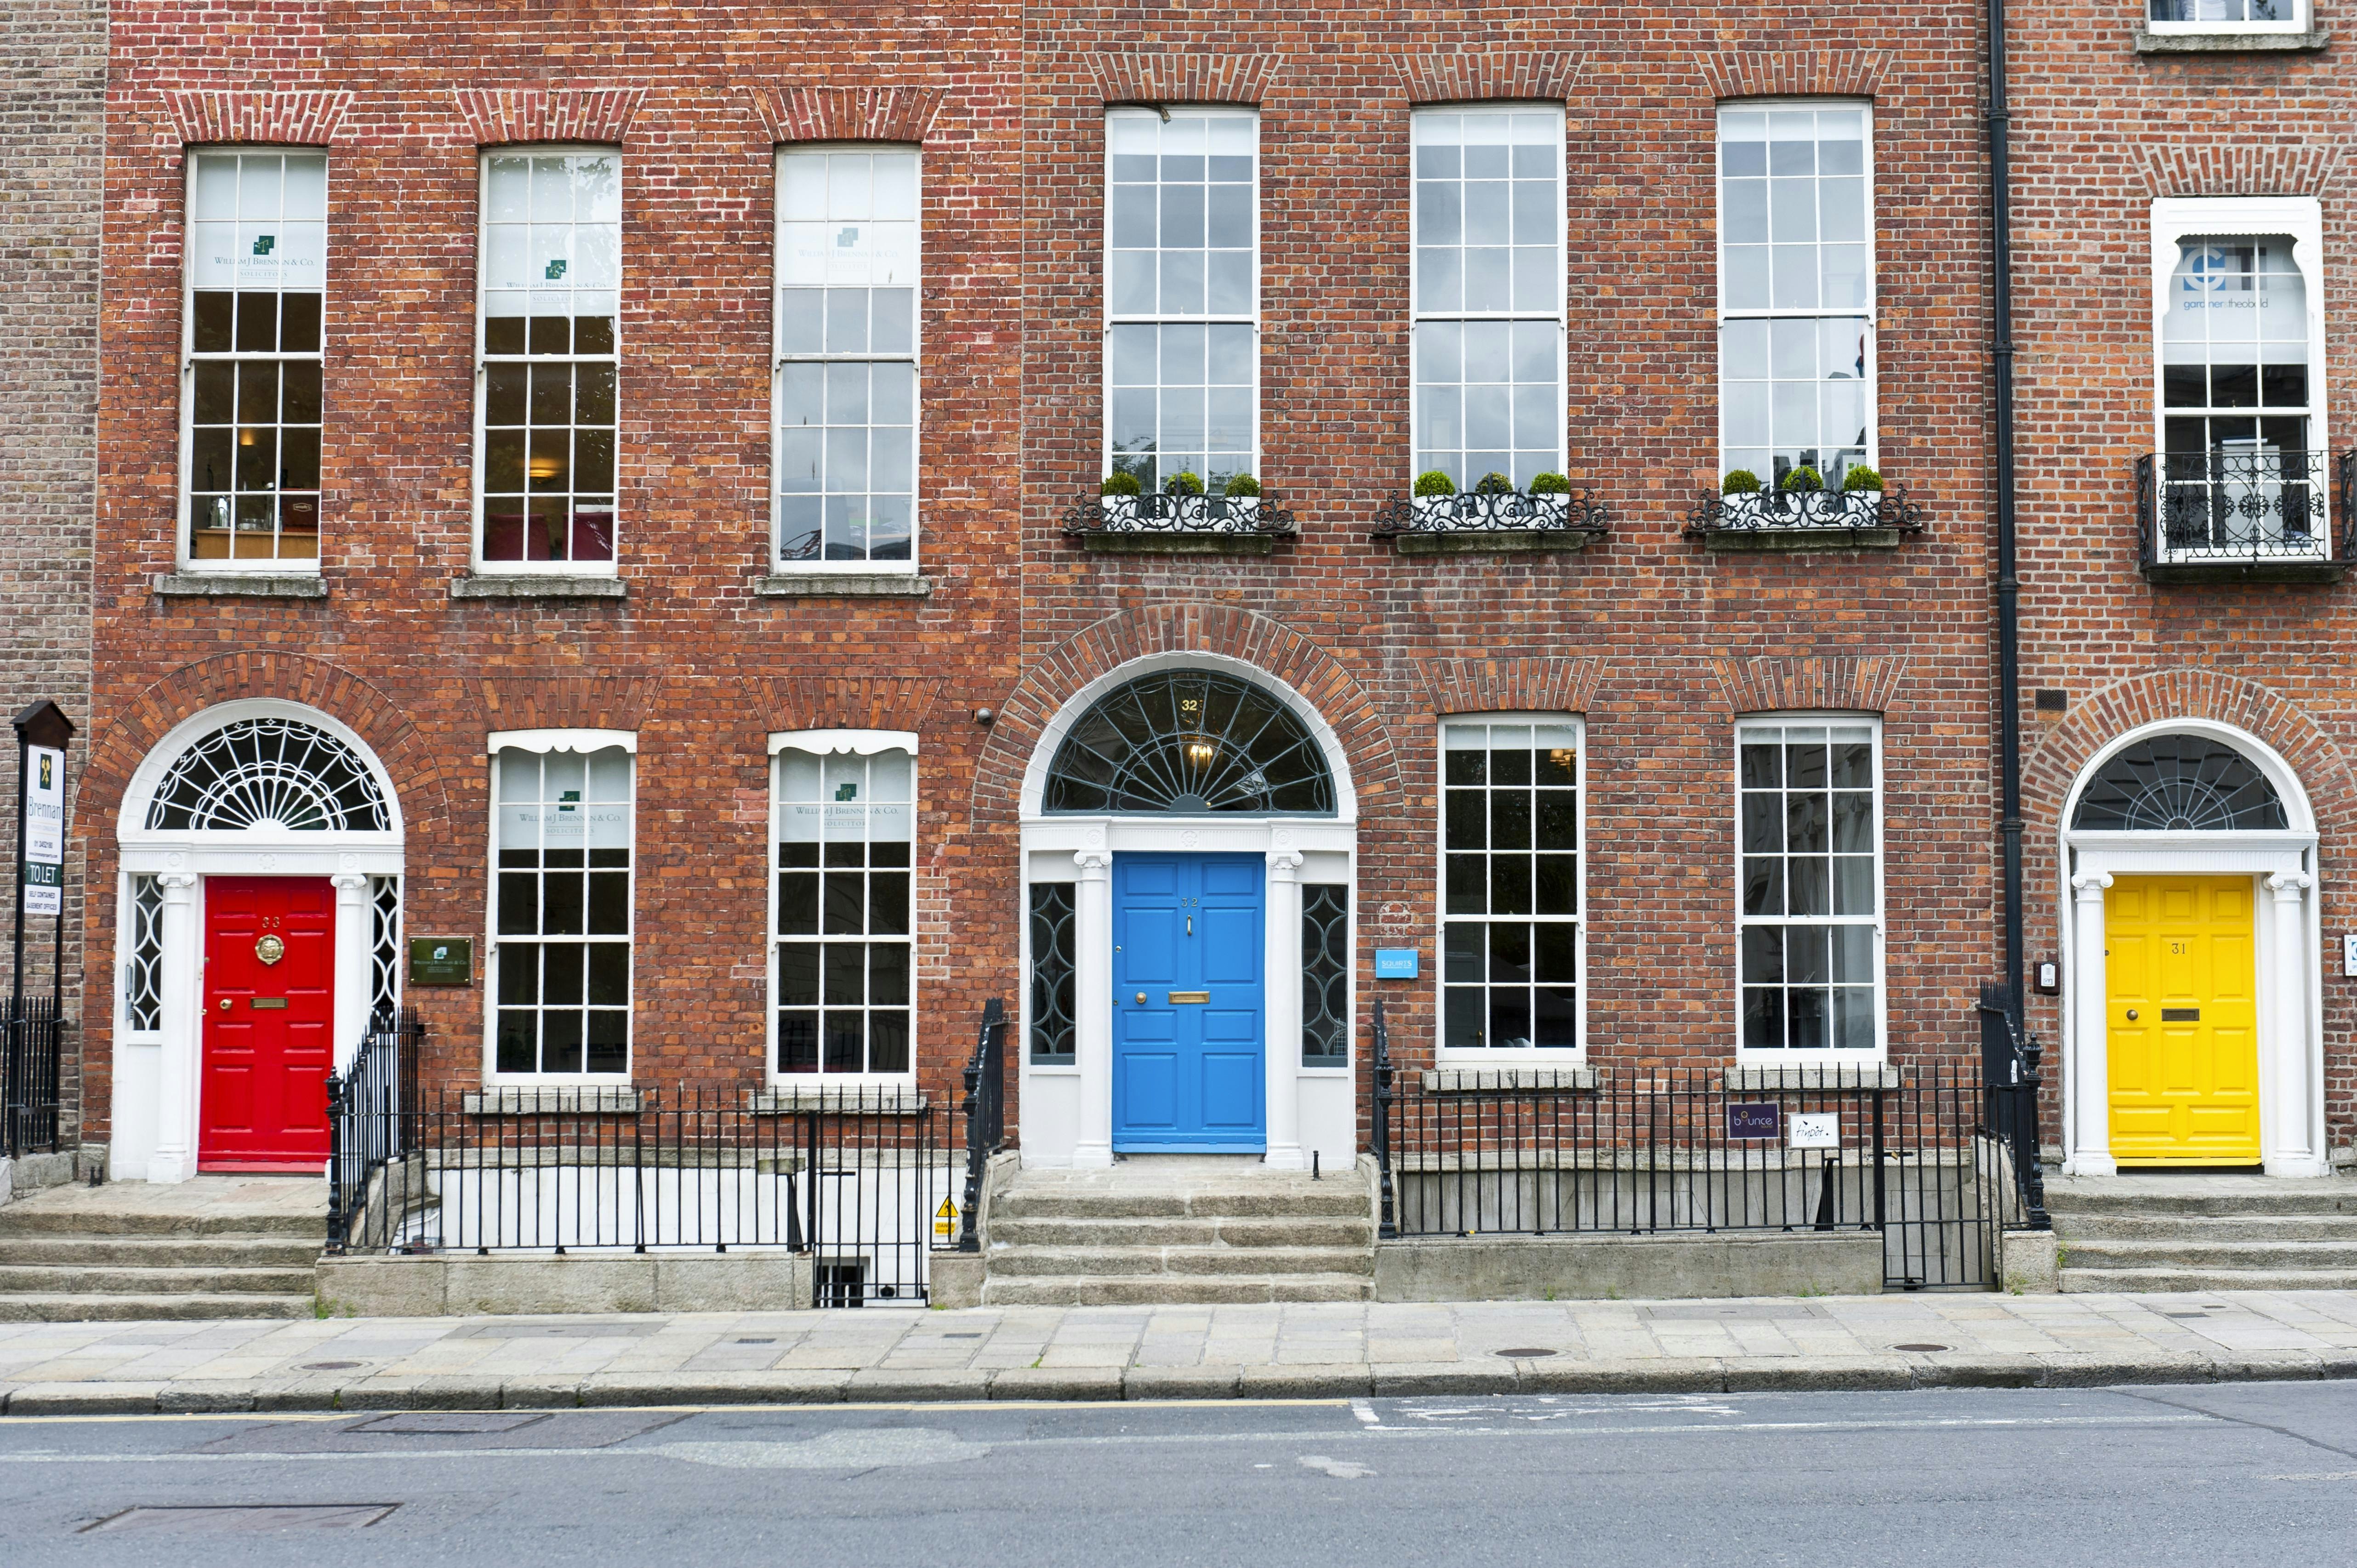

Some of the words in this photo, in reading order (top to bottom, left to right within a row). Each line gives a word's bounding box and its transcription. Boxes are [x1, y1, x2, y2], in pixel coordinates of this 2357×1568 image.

[246, 257, 250, 267] J
[2184, 298, 2224, 310] gardner
[2228, 298, 2268, 308] theobld
[1181, 699, 1197, 711] 32
[28, 796, 61, 820] Brennan
[829, 807, 833, 817] J
[552, 814, 556, 823] J
[29, 865, 40, 882] TO
[41, 866, 56, 883] LET
[1181, 898, 1198, 907] 32
[262, 916, 279, 928] 33
[2172, 943, 2185, 954] 31
[1734, 1111, 1773, 1126] bounce
